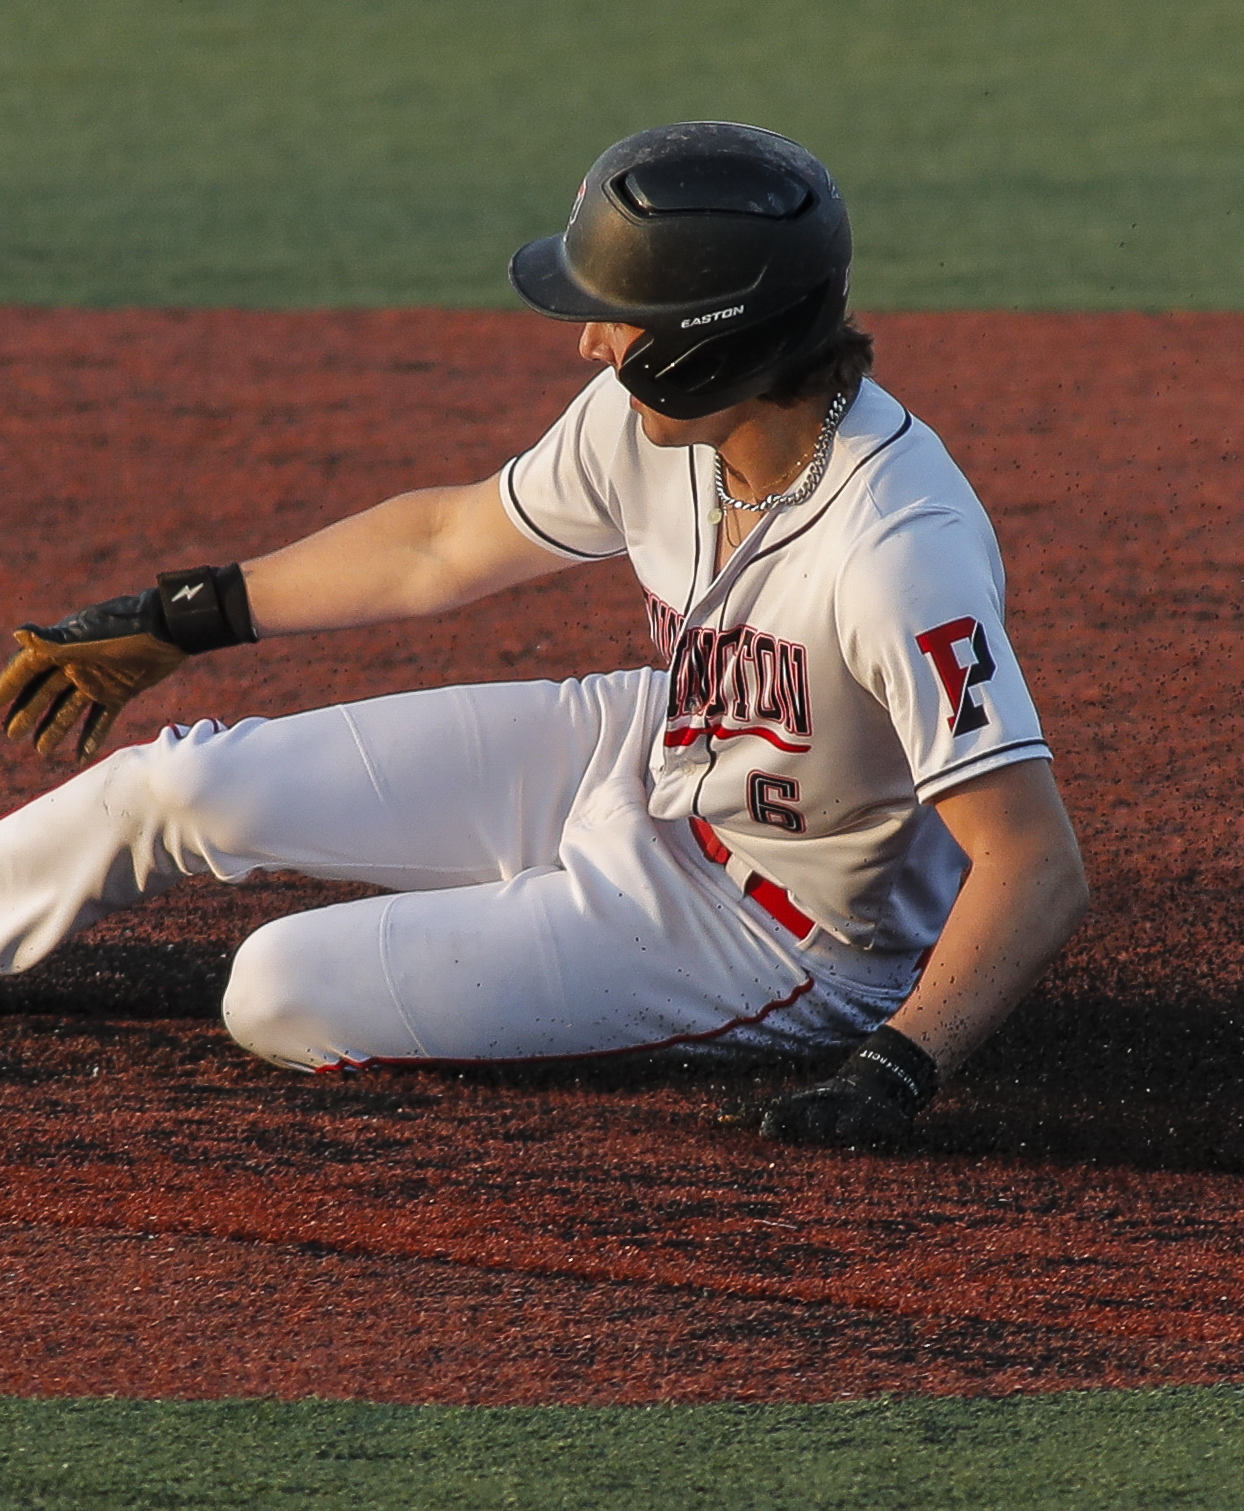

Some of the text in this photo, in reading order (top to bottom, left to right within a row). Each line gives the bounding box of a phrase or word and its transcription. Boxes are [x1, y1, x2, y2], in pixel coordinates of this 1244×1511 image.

[680, 304, 745, 330] EASTON
[915, 613, 998, 739] P
[746, 768, 807, 834] 6
